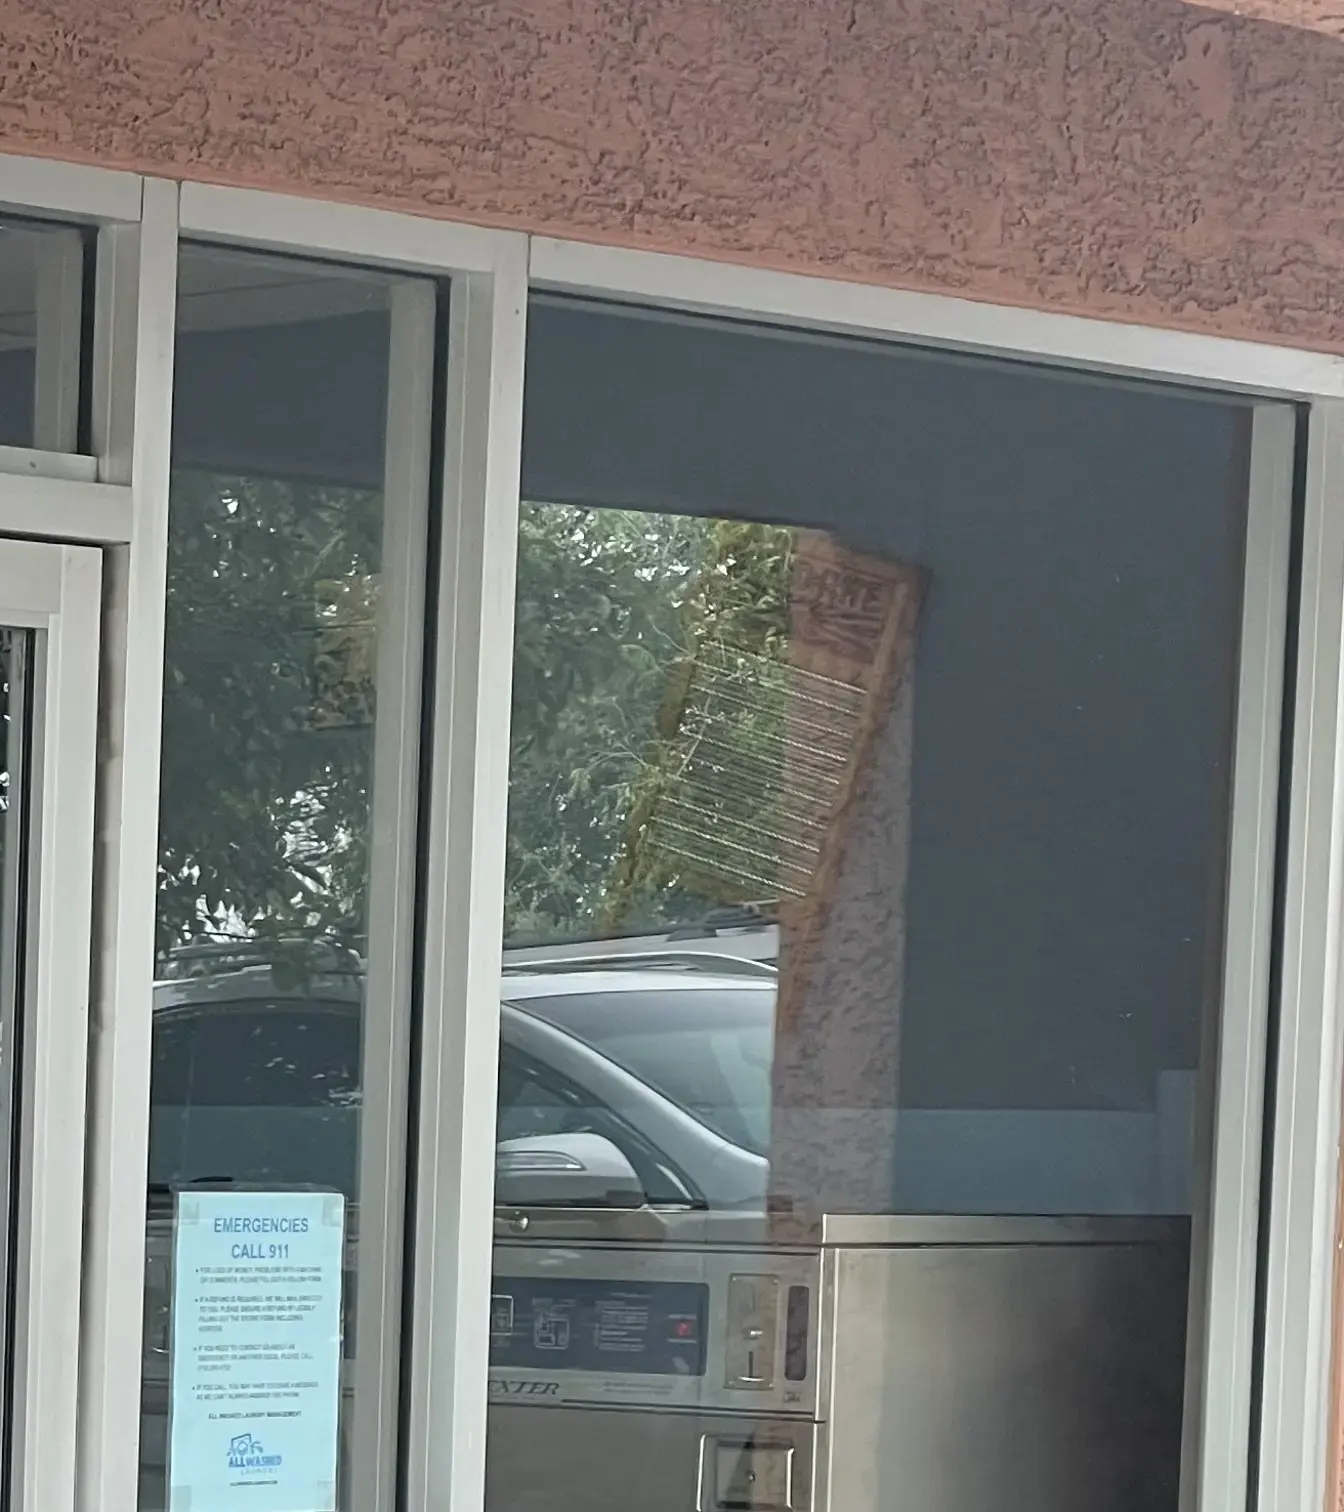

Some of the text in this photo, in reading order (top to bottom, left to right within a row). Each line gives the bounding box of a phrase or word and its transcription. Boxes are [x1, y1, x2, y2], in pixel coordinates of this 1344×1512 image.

[214, 1217, 309, 1233] EMERGENCIES
[231, 1244, 289, 1259] CALL 911
[489, 1380, 560, 1395] EXTER
